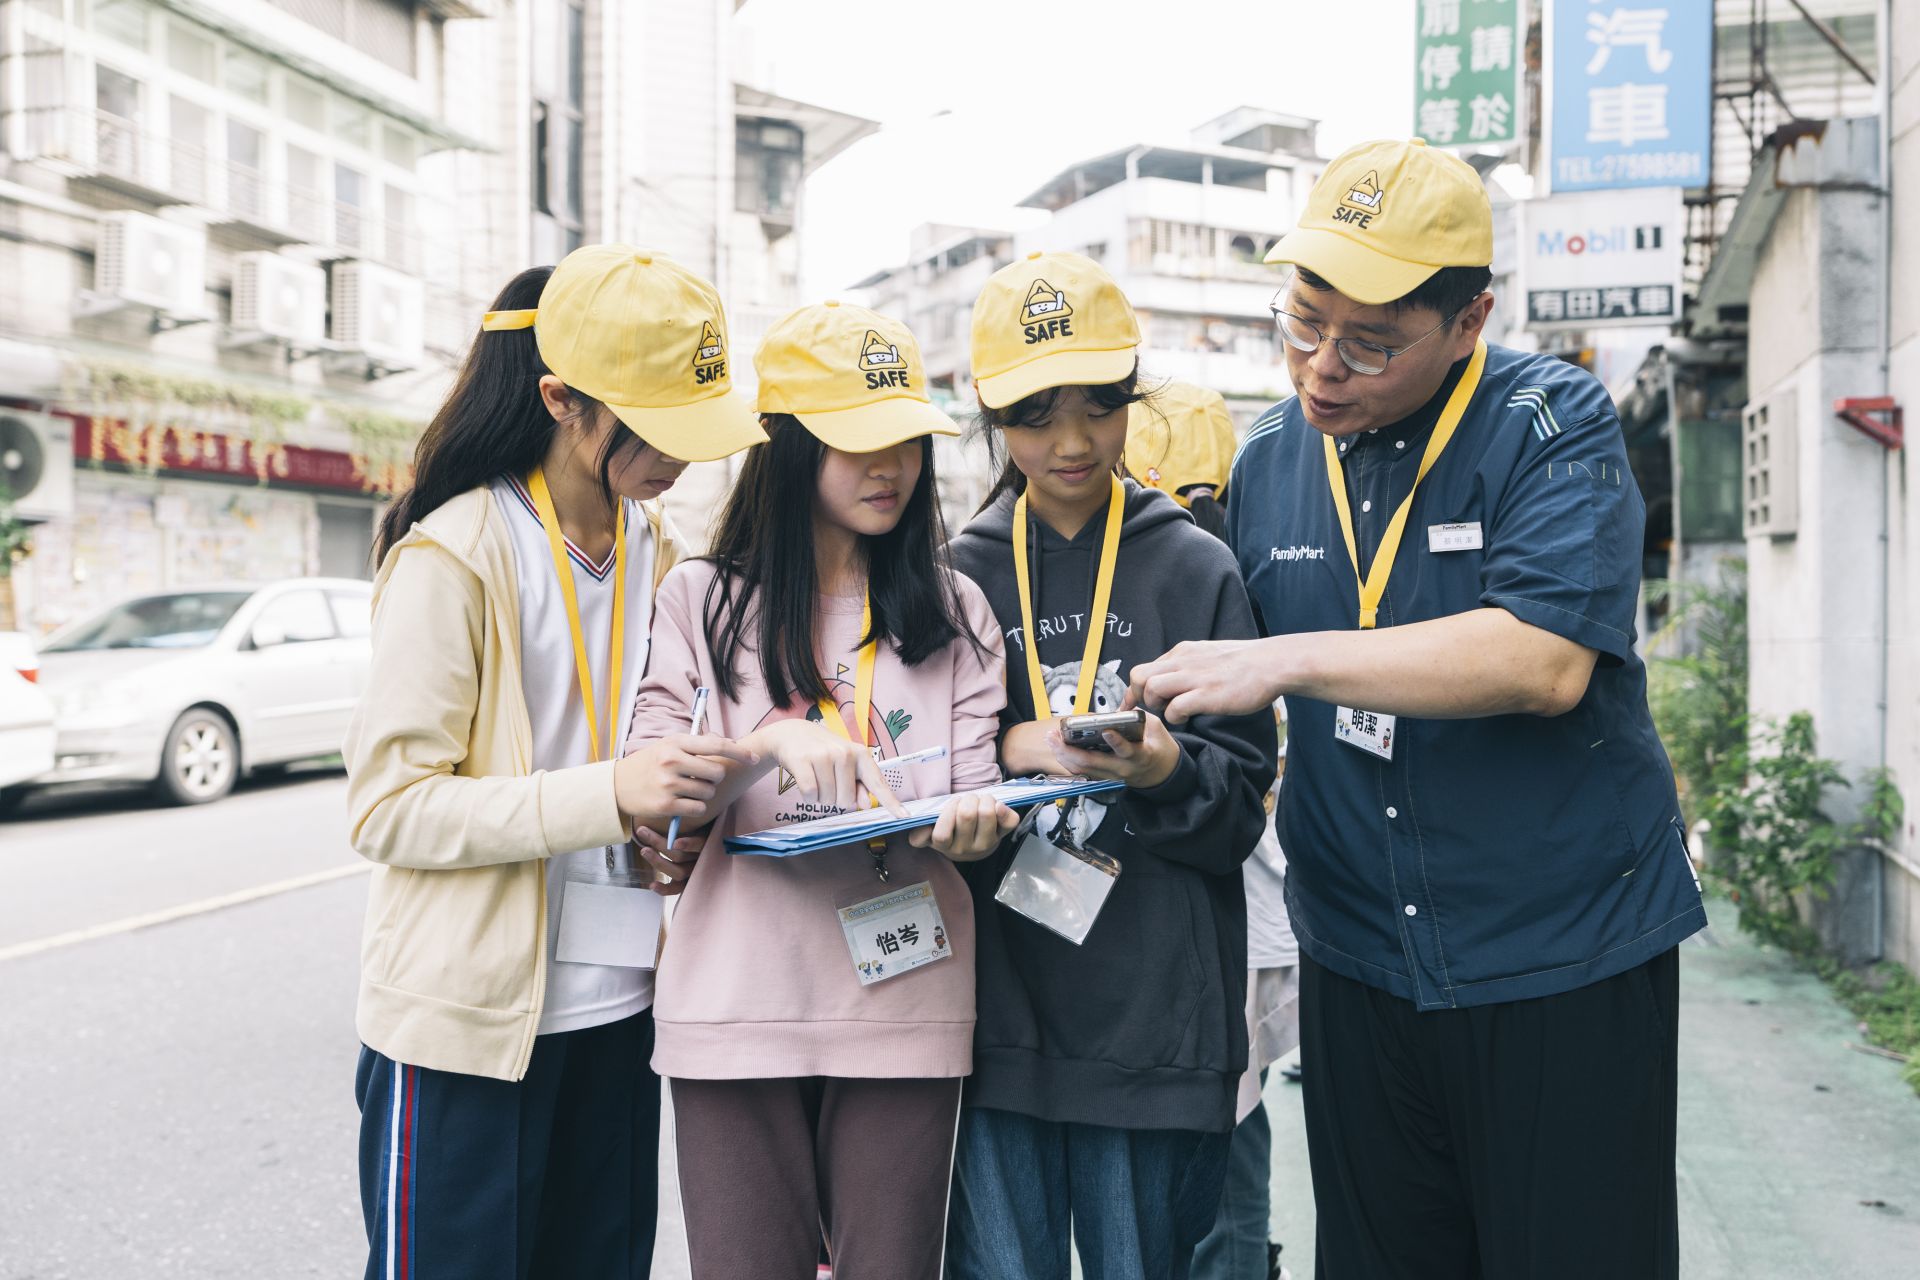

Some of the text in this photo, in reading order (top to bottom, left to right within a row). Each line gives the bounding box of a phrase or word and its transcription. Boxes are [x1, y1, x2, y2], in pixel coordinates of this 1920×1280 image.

[1469, 0, 1511, 140] 請於
[1585, 0, 1673, 146] 汽車
[1332, 206, 1373, 229] SAFE
[1537, 225, 1626, 256] Mobil
[1533, 286, 1671, 318] 有田汽車
[1024, 318, 1073, 344] SAFE
[695, 361, 725, 384] SAFE
[865, 371, 910, 389] SAFE
[1270, 545, 1325, 562] FamilyMart
[1006, 611, 1133, 652] TRUTRU
[796, 802, 846, 815] HOLIDAY
[876, 922, 919, 956] 怡岑
